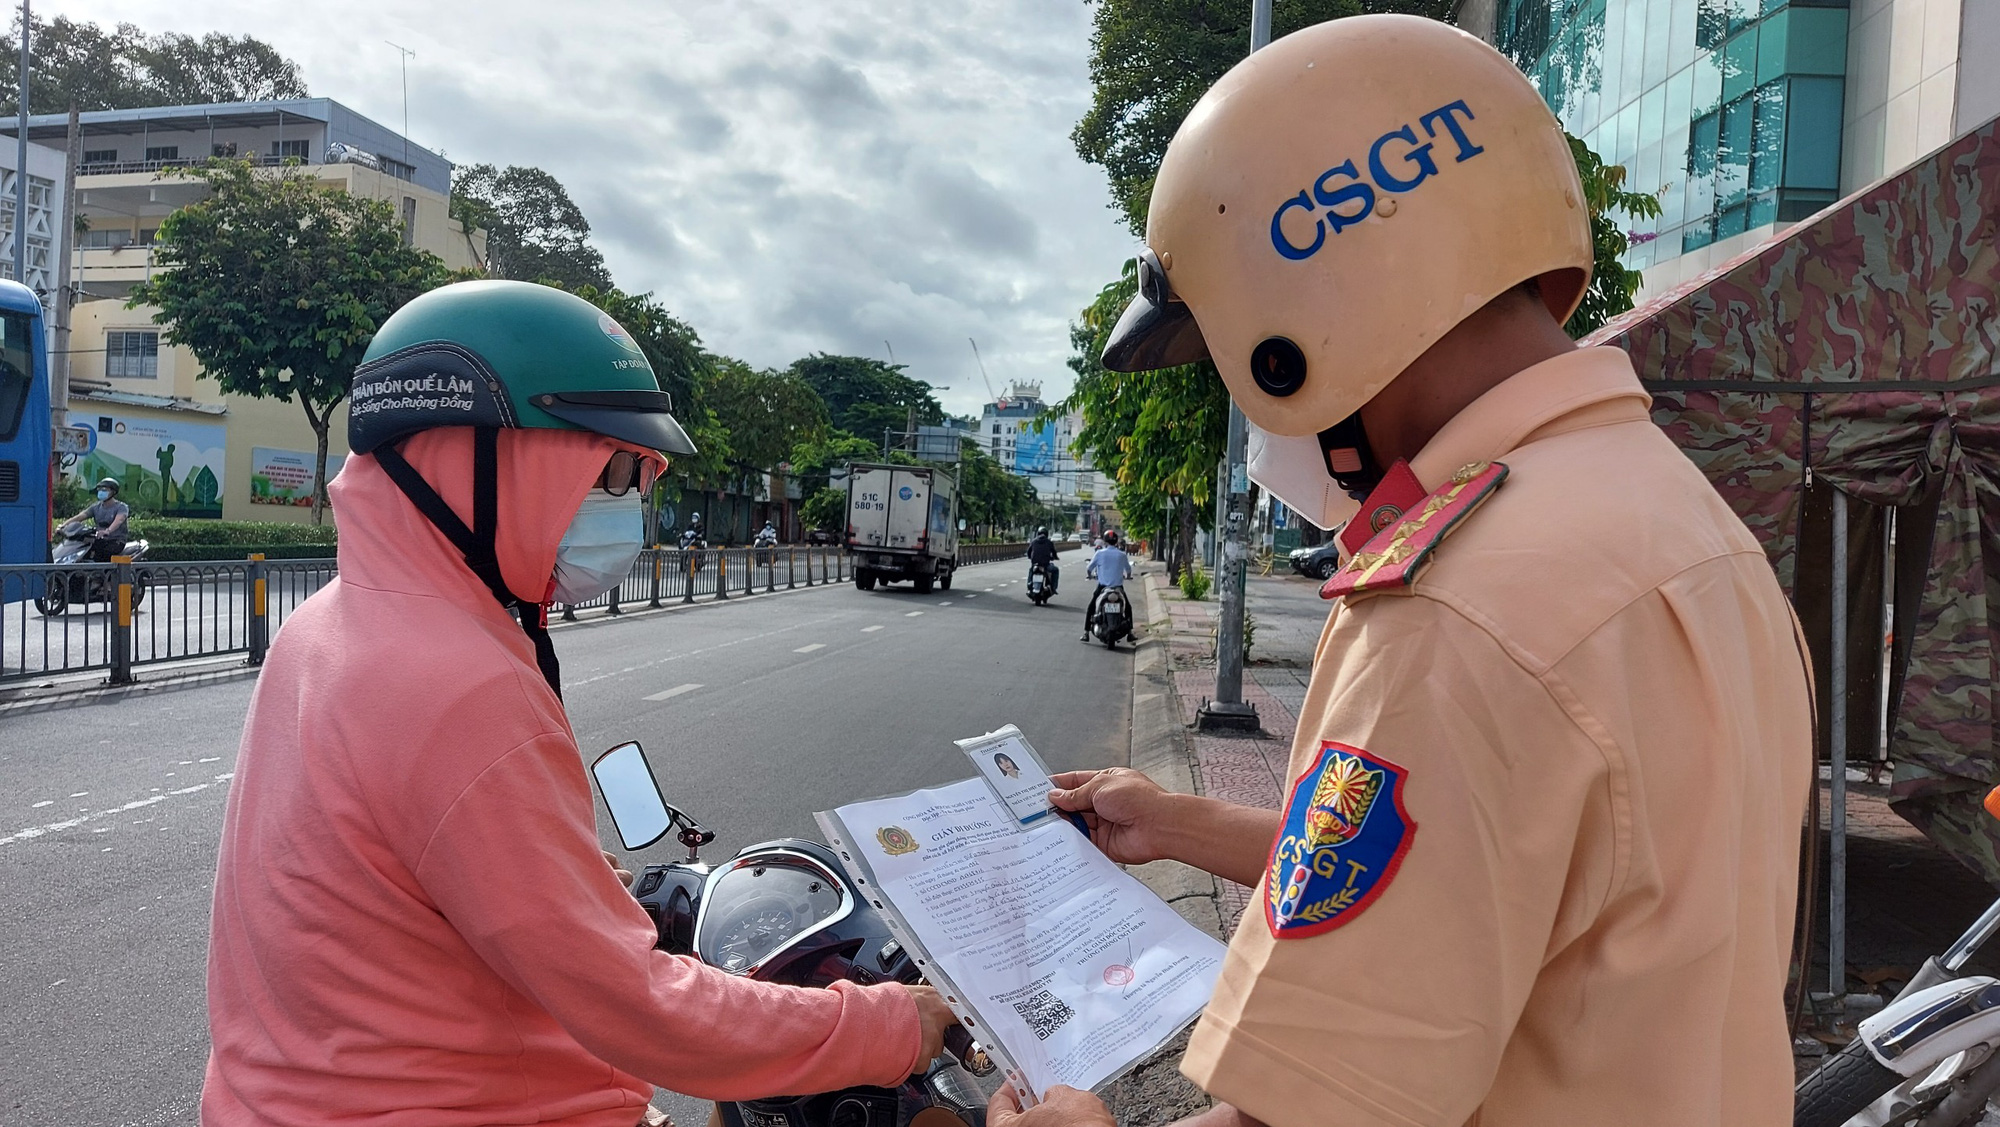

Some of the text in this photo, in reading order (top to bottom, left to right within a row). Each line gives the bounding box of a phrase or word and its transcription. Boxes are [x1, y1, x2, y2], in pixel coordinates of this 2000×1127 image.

[1271, 99, 1484, 260] CSGT
[352, 373, 473, 401] PHÂN BÓN QUẾ LÂM
[381, 397, 400, 410] Cho
[401, 394, 438, 411] Ruộng
[440, 393, 474, 411] Đồng
[862, 493, 878, 502] 51C
[1313, 811, 1342, 831] CAND
[1279, 835, 1368, 888] CSGT
